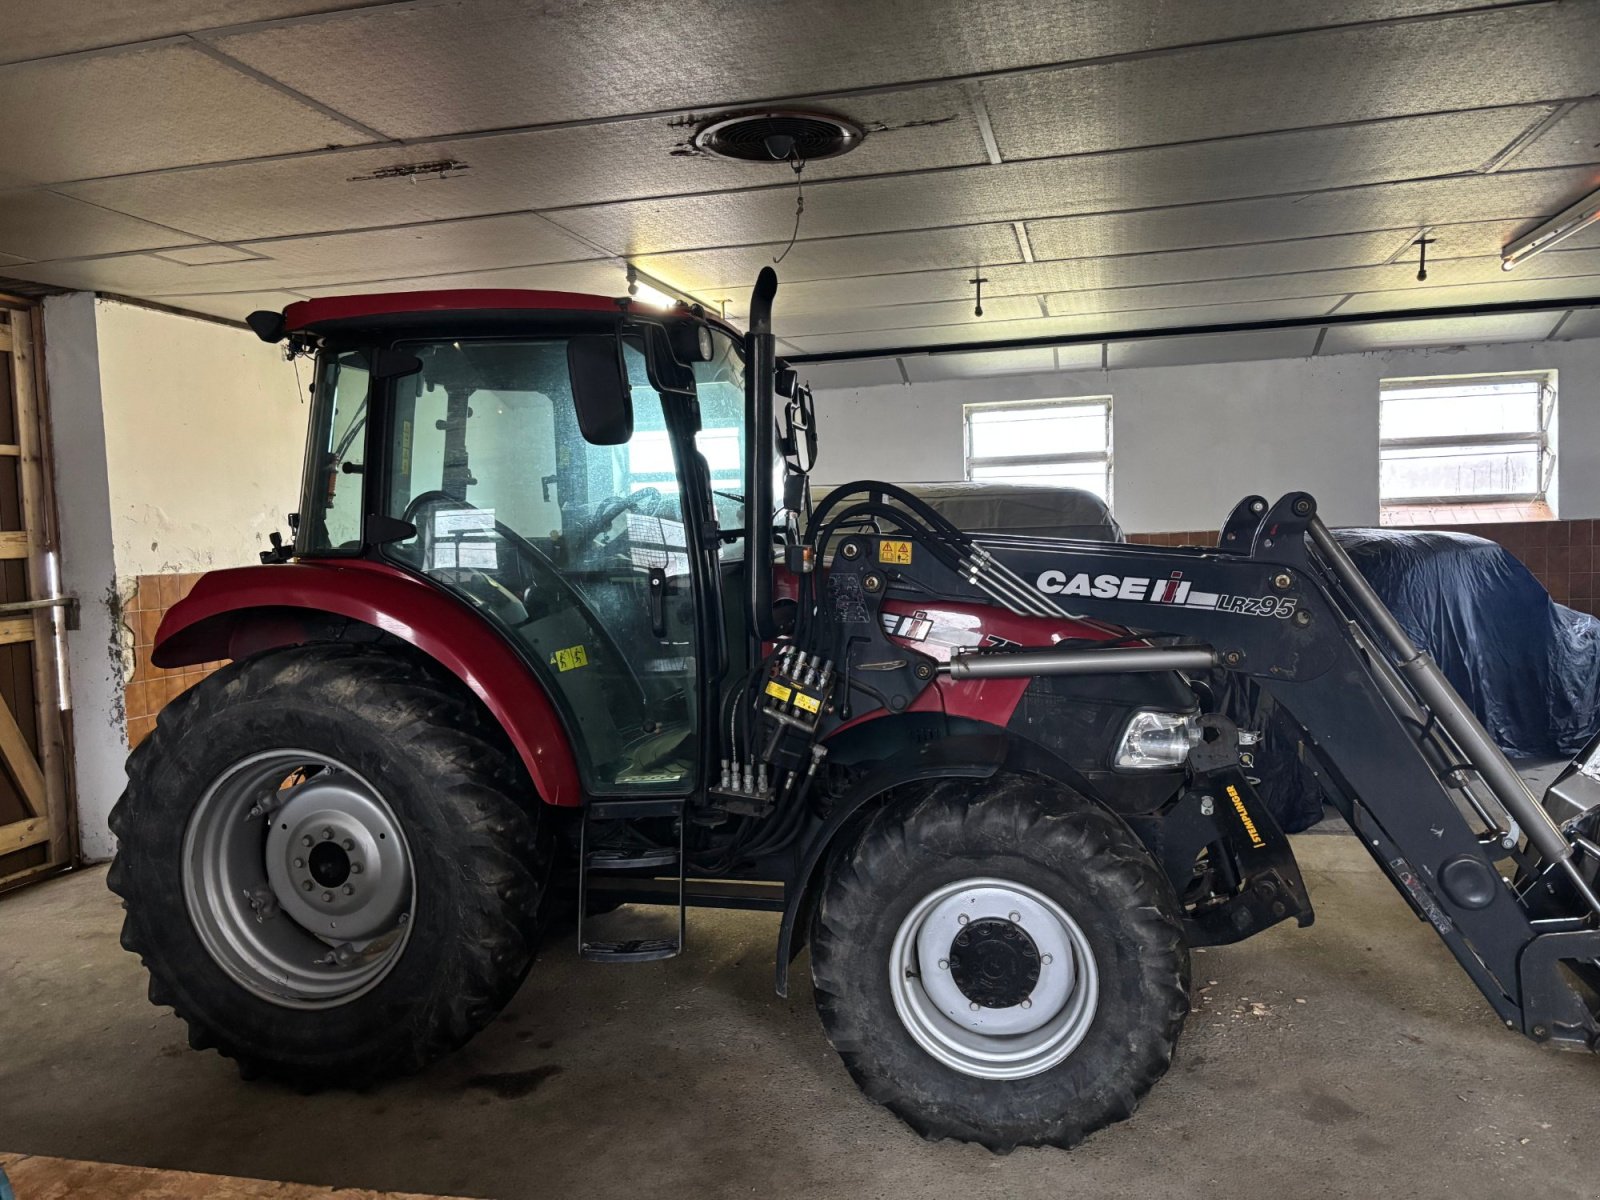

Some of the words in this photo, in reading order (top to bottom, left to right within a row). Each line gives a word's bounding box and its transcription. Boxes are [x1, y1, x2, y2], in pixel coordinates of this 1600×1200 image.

[1036, 570, 1150, 600] CASE
[1215, 594, 1298, 619] LRZ95
[1226, 784, 1262, 843] STEMPLINGER
